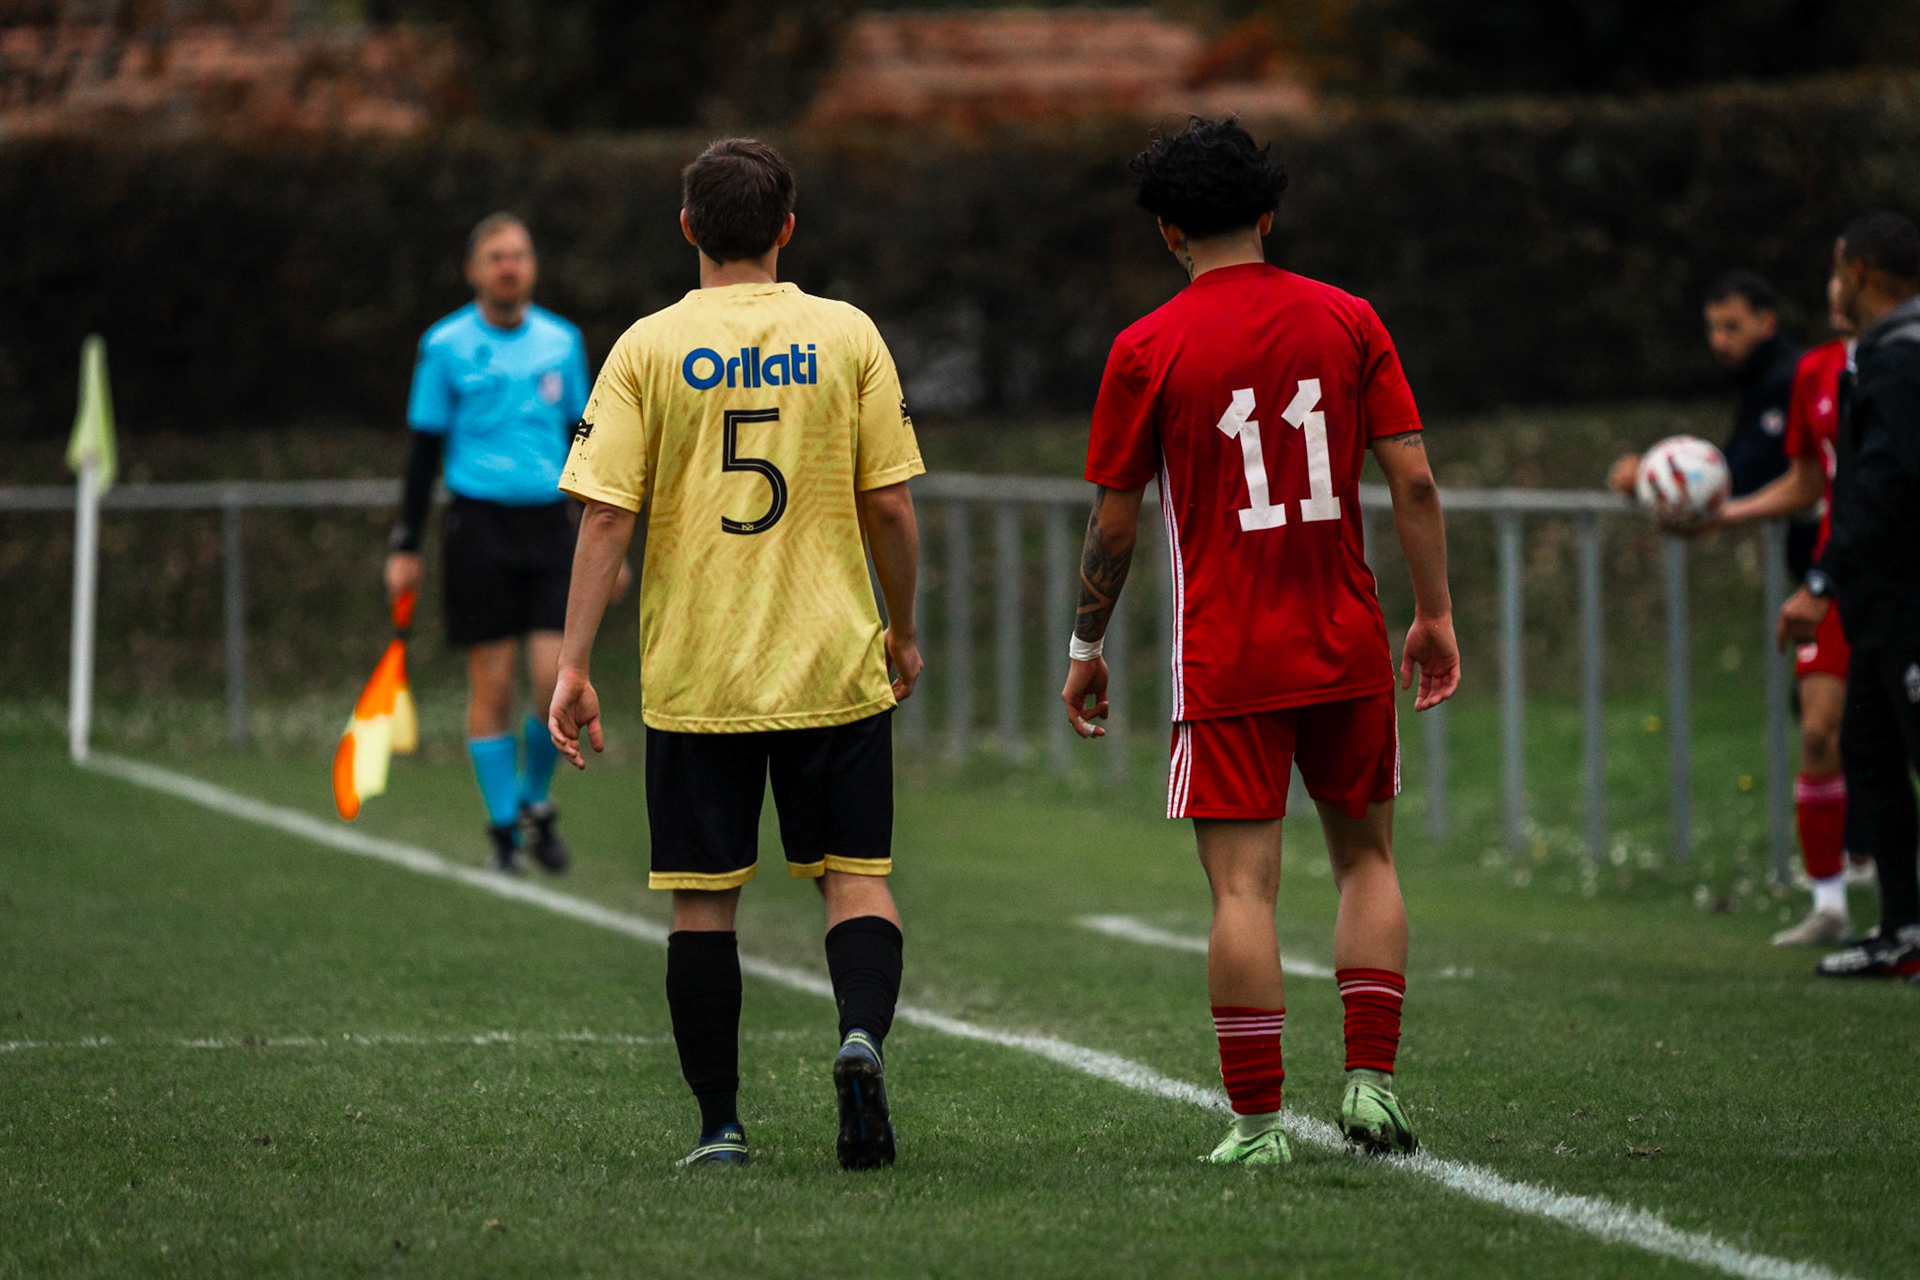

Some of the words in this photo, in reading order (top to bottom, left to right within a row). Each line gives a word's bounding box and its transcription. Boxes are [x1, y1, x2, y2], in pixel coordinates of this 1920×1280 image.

[682, 343, 817, 390] Orllati
[721, 407, 788, 535] 5
[1216, 378, 1341, 532] 11
[723, 1132, 743, 1141] KING
